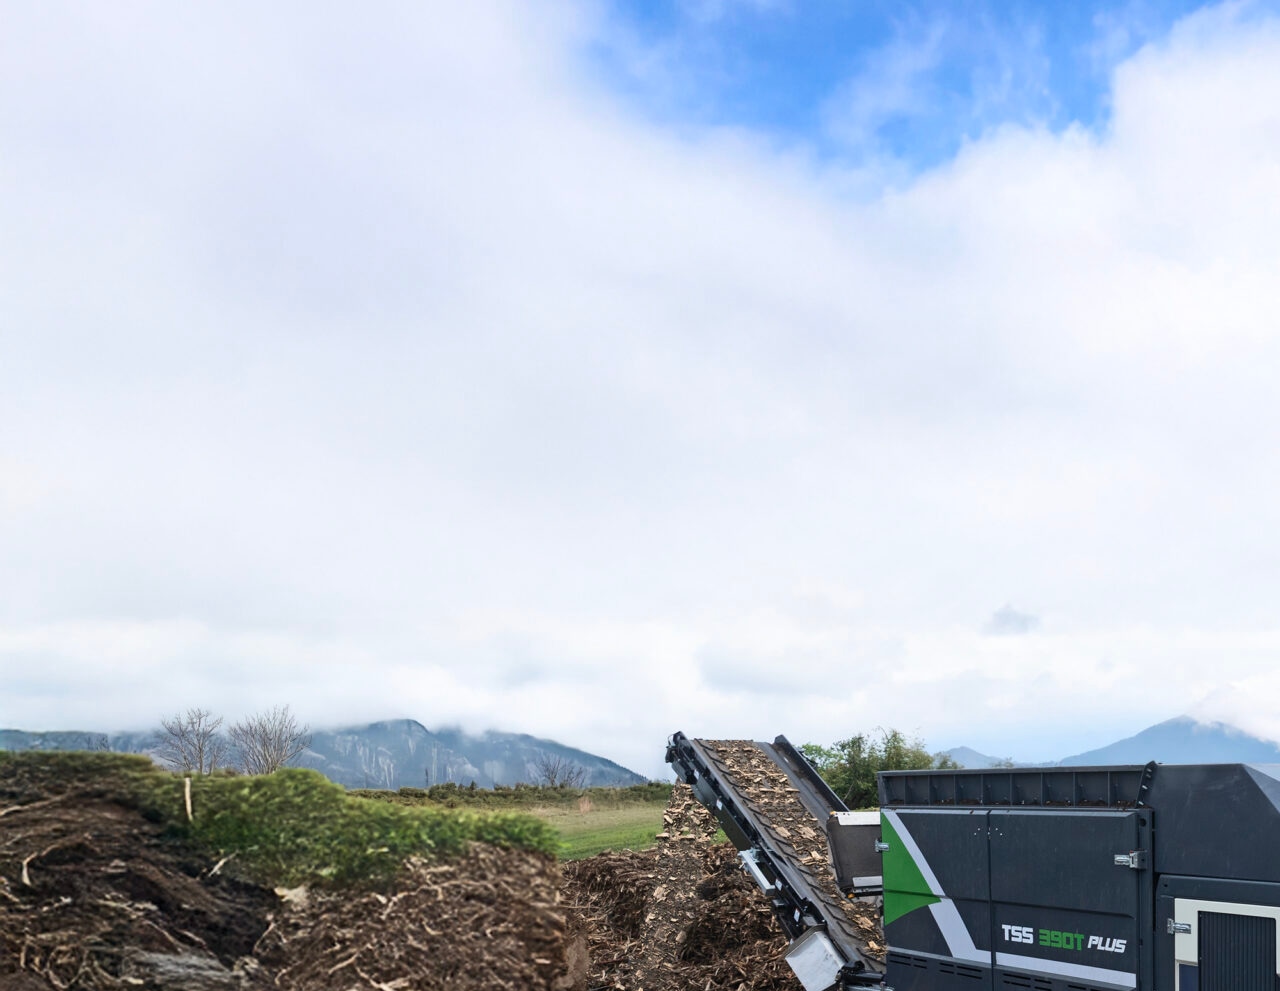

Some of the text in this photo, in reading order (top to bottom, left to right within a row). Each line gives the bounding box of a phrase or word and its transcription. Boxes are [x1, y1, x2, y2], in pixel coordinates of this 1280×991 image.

[1001, 924, 1127, 953] TSS 390T PLUS
